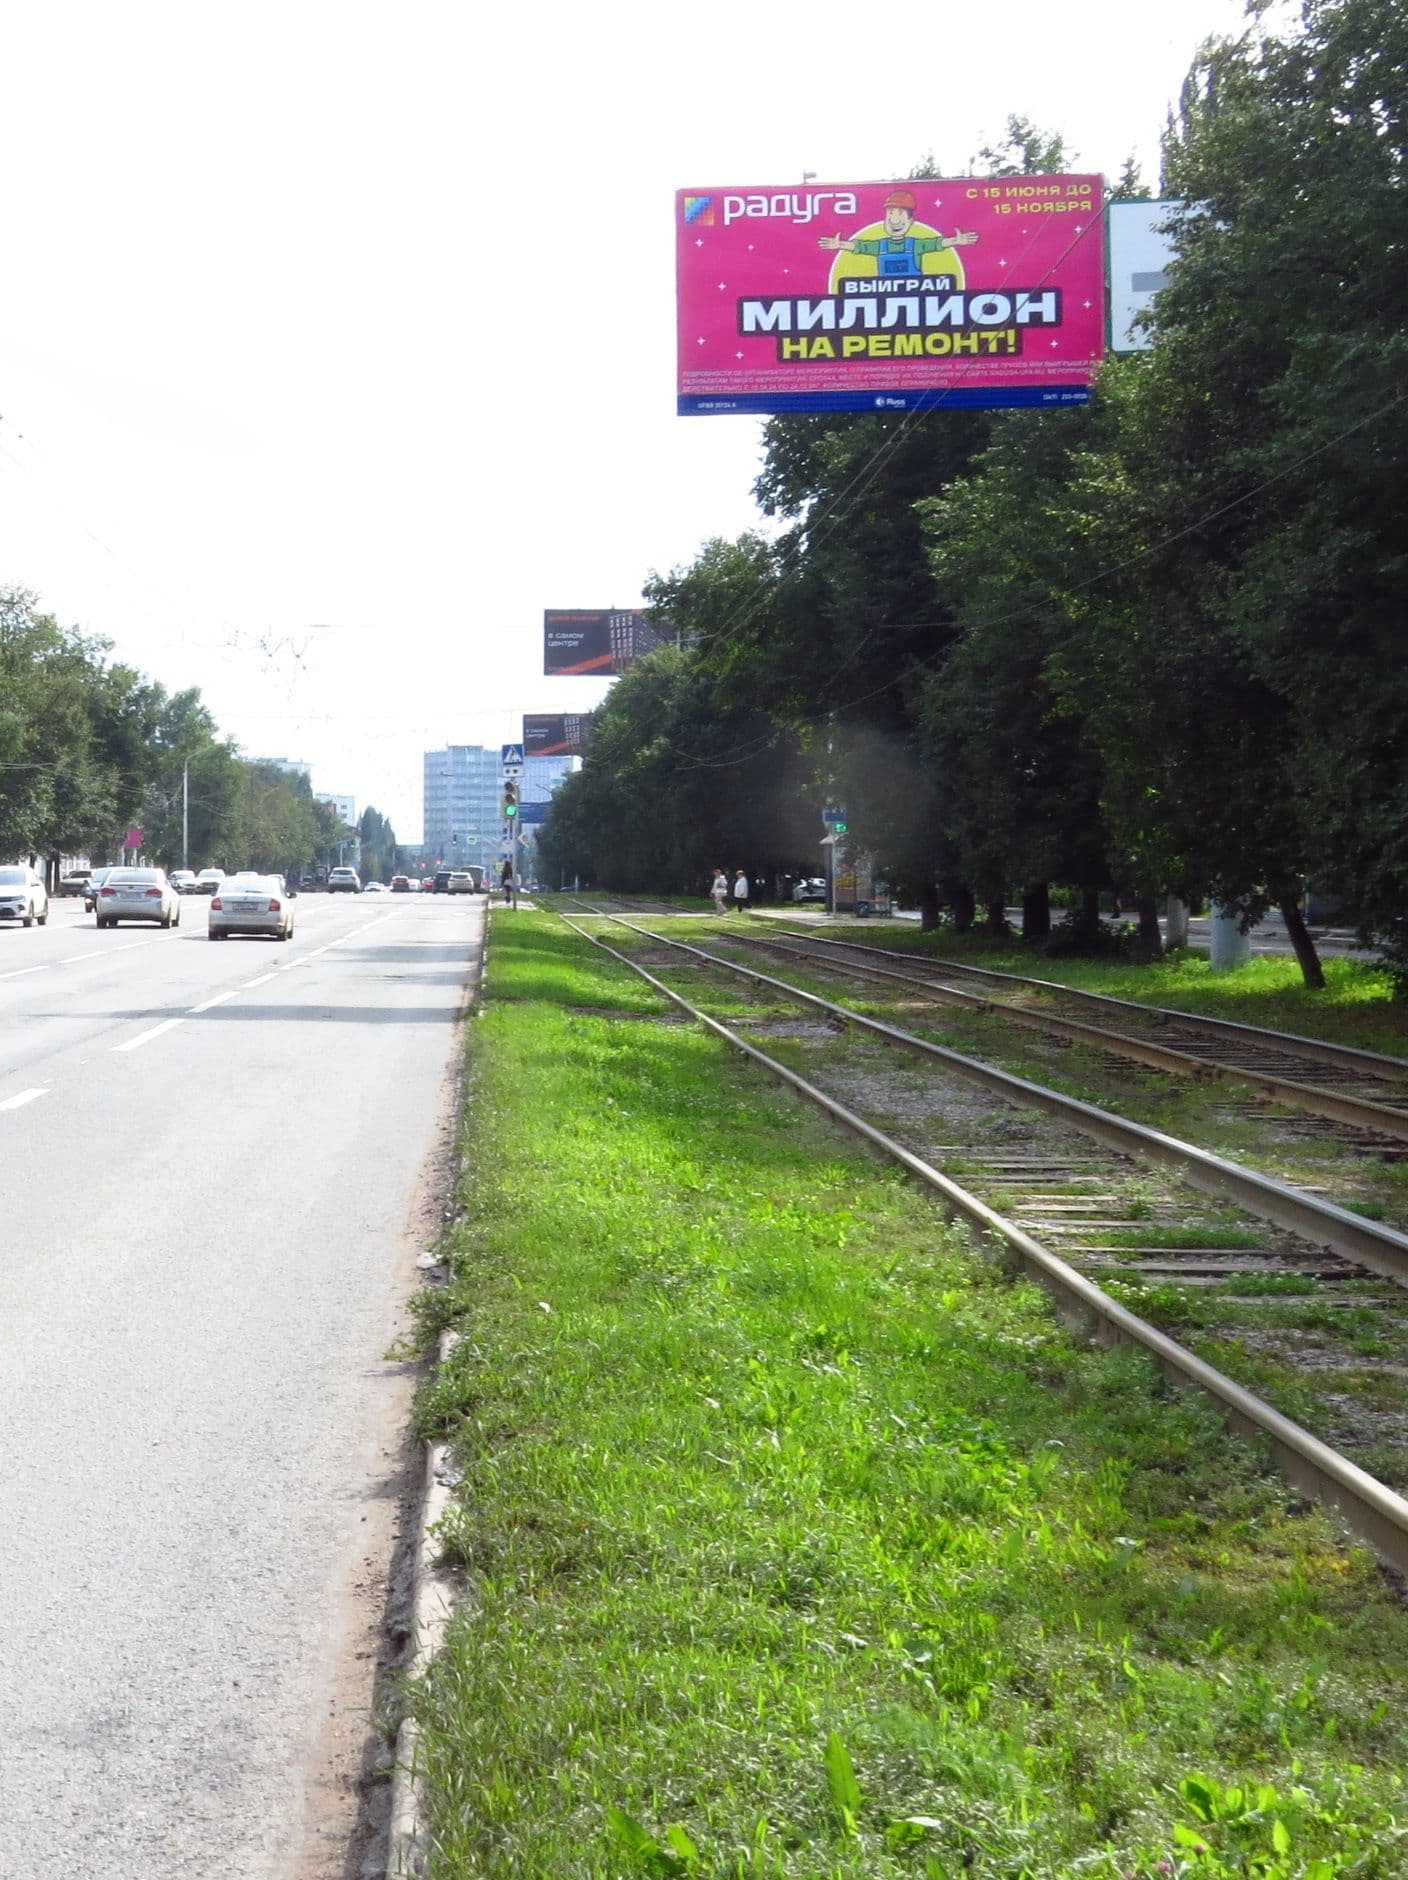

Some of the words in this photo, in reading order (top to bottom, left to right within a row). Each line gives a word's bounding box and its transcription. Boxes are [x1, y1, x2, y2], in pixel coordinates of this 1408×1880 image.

[966, 188, 978, 199] С
[983, 187, 1001, 198] 15
[1005, 185, 1060, 197] ИЮНЯ
[1065, 184, 1092, 196] ДО
[723, 192, 857, 226] радуга
[993, 203, 1012, 214] 15
[1016, 200, 1092, 213] НОЯБРЯ
[844, 276, 951, 294] ВЫИГРАЙ
[742, 292, 1056, 332] МИЛЛИОН
[782, 335, 836, 359] НА
[842, 329, 1016, 357] РЕМОНТ!
